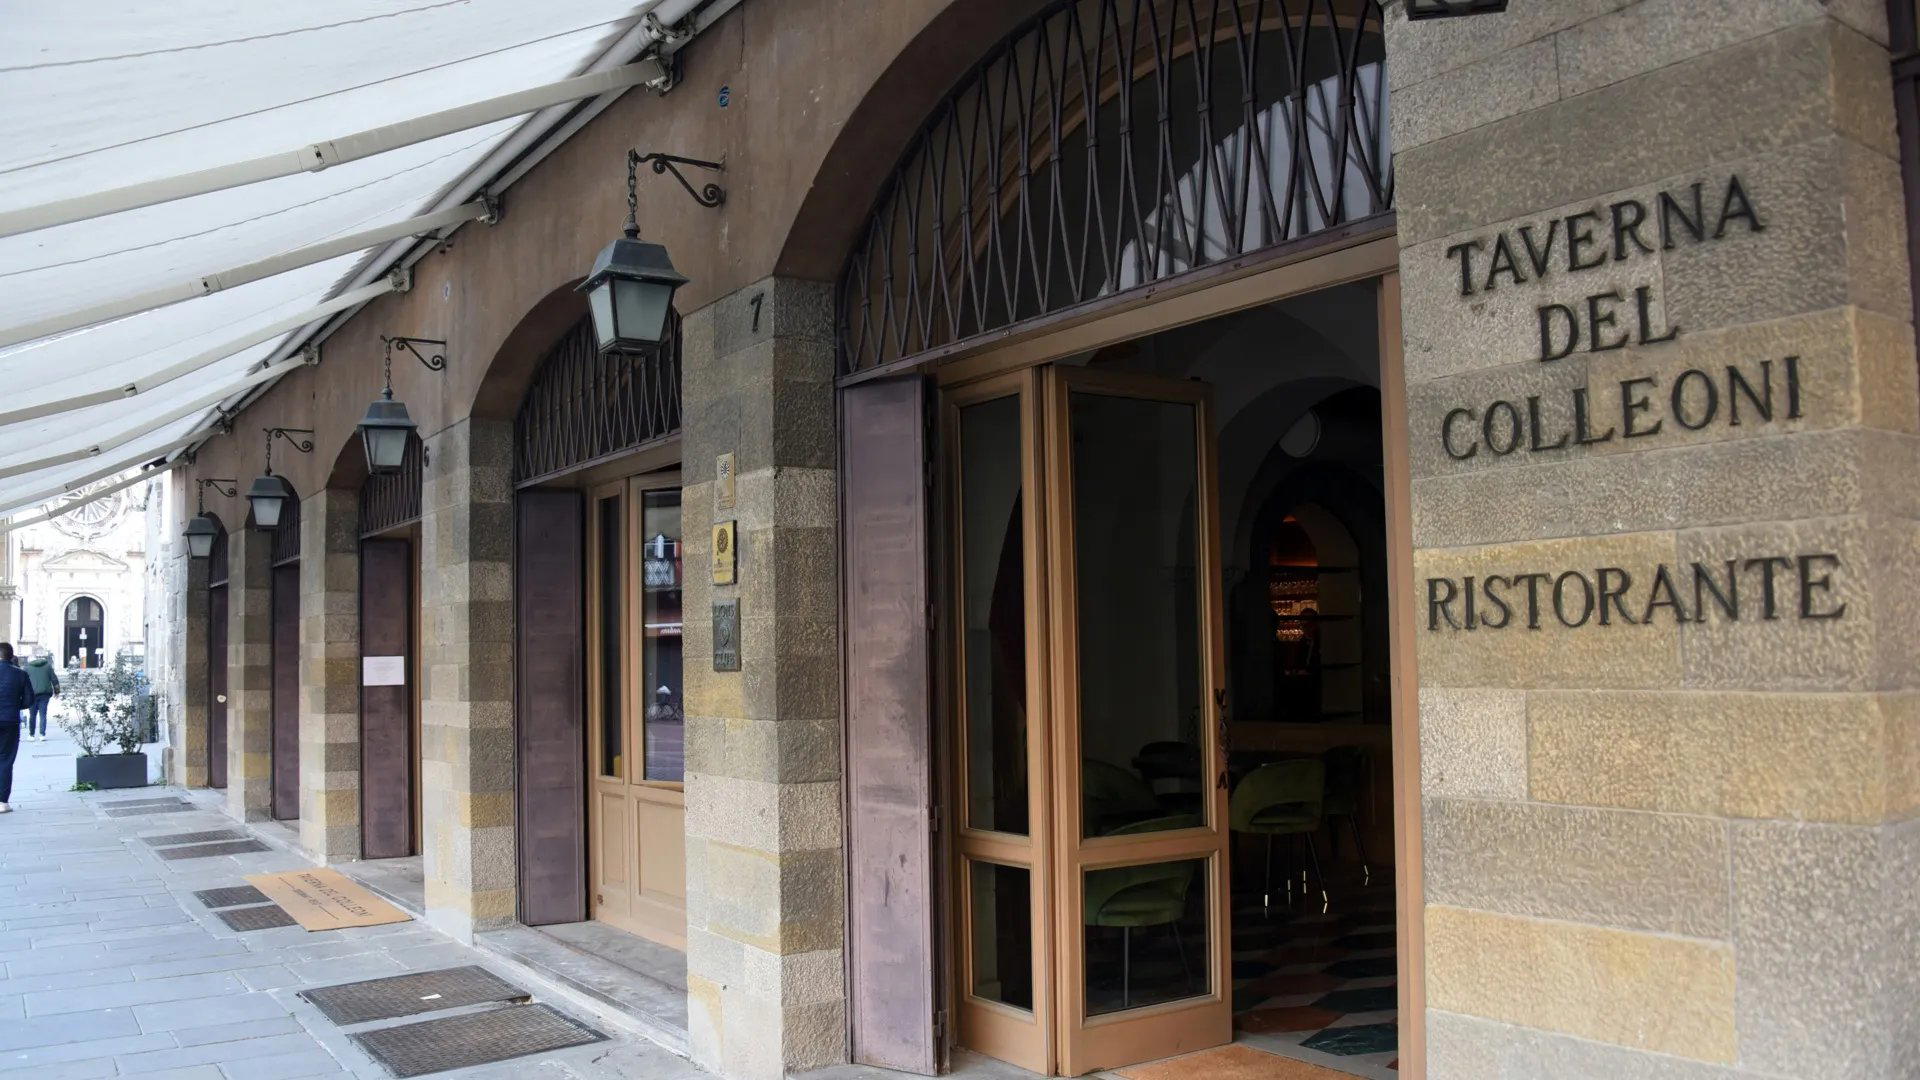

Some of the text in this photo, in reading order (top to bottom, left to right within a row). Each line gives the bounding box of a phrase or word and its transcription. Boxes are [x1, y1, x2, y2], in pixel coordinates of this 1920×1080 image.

[1447, 174, 1765, 296] TAVERNA
[751, 292, 765, 333] 7
[1538, 286, 1679, 363] DEL
[1442, 356, 1805, 461] COLLEONI
[1426, 553, 1847, 632] RISTORANTE
